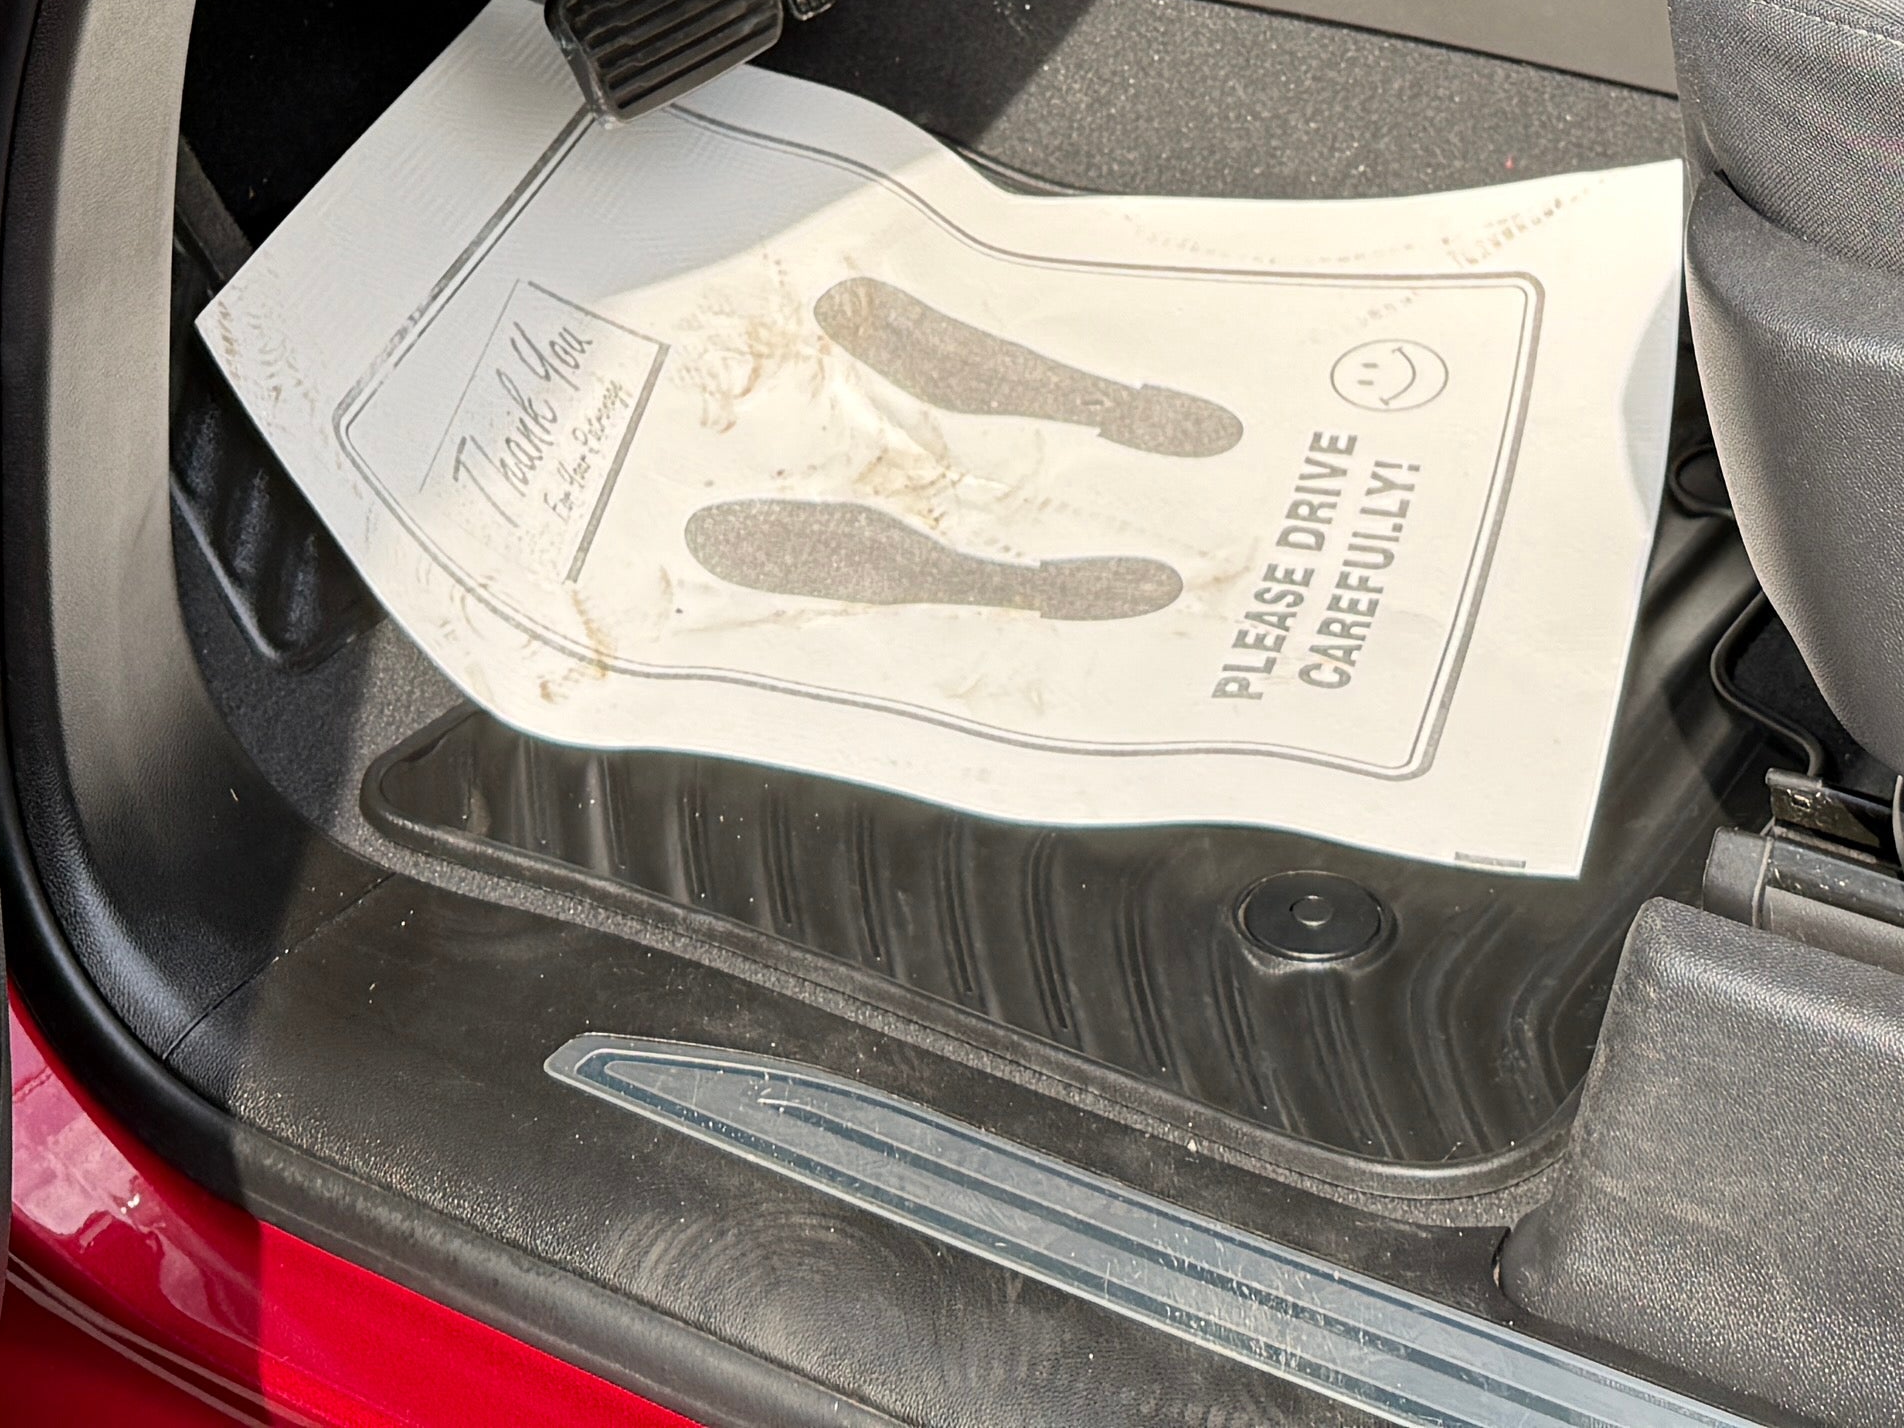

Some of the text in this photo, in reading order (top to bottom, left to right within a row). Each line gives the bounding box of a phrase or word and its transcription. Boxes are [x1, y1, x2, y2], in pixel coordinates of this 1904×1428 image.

[452, 320, 594, 529] Thank You
[1210, 430, 1358, 701] PLEASE DRIVE
[1297, 459, 1422, 690] CAREFULLY!
